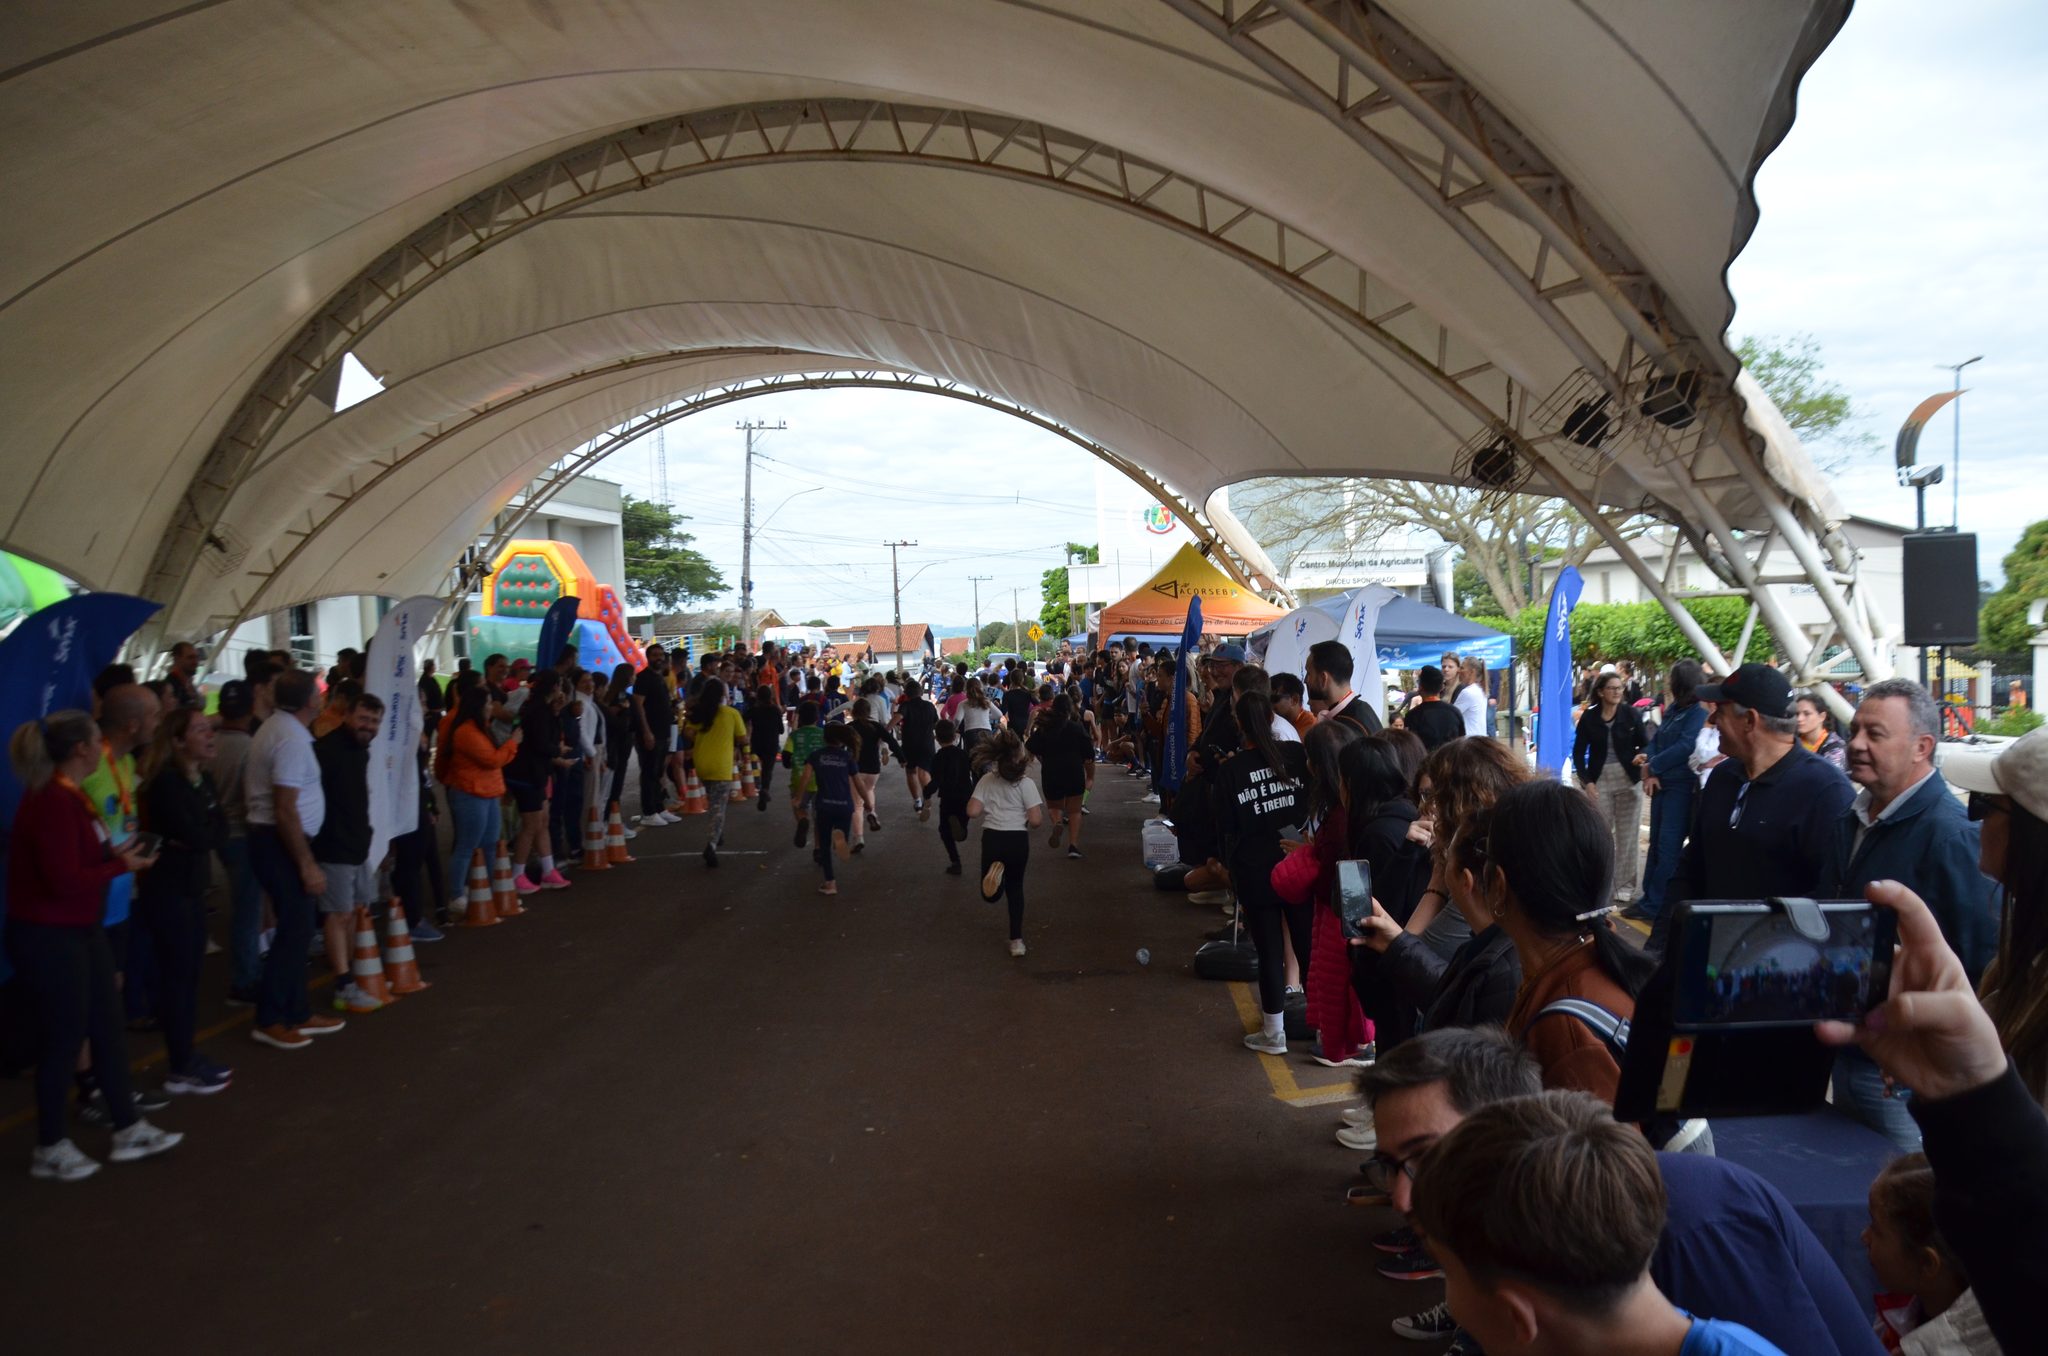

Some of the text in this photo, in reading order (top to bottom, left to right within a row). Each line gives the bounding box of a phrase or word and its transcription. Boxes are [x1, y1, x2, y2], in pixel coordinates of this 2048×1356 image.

[1300, 561, 1326, 569] Centro
[1328, 560, 1366, 569] Municipal
[1380, 558, 1423, 568] Agricultura
[1179, 588, 1228, 596] ACORSEB
[1120, 617, 1159, 626] Associação
[1354, 602, 1366, 640] Senac
[1237, 787, 1259, 805] NÃO
[1260, 783, 1268, 797] É
[1253, 794, 1295, 815] É TREINO
